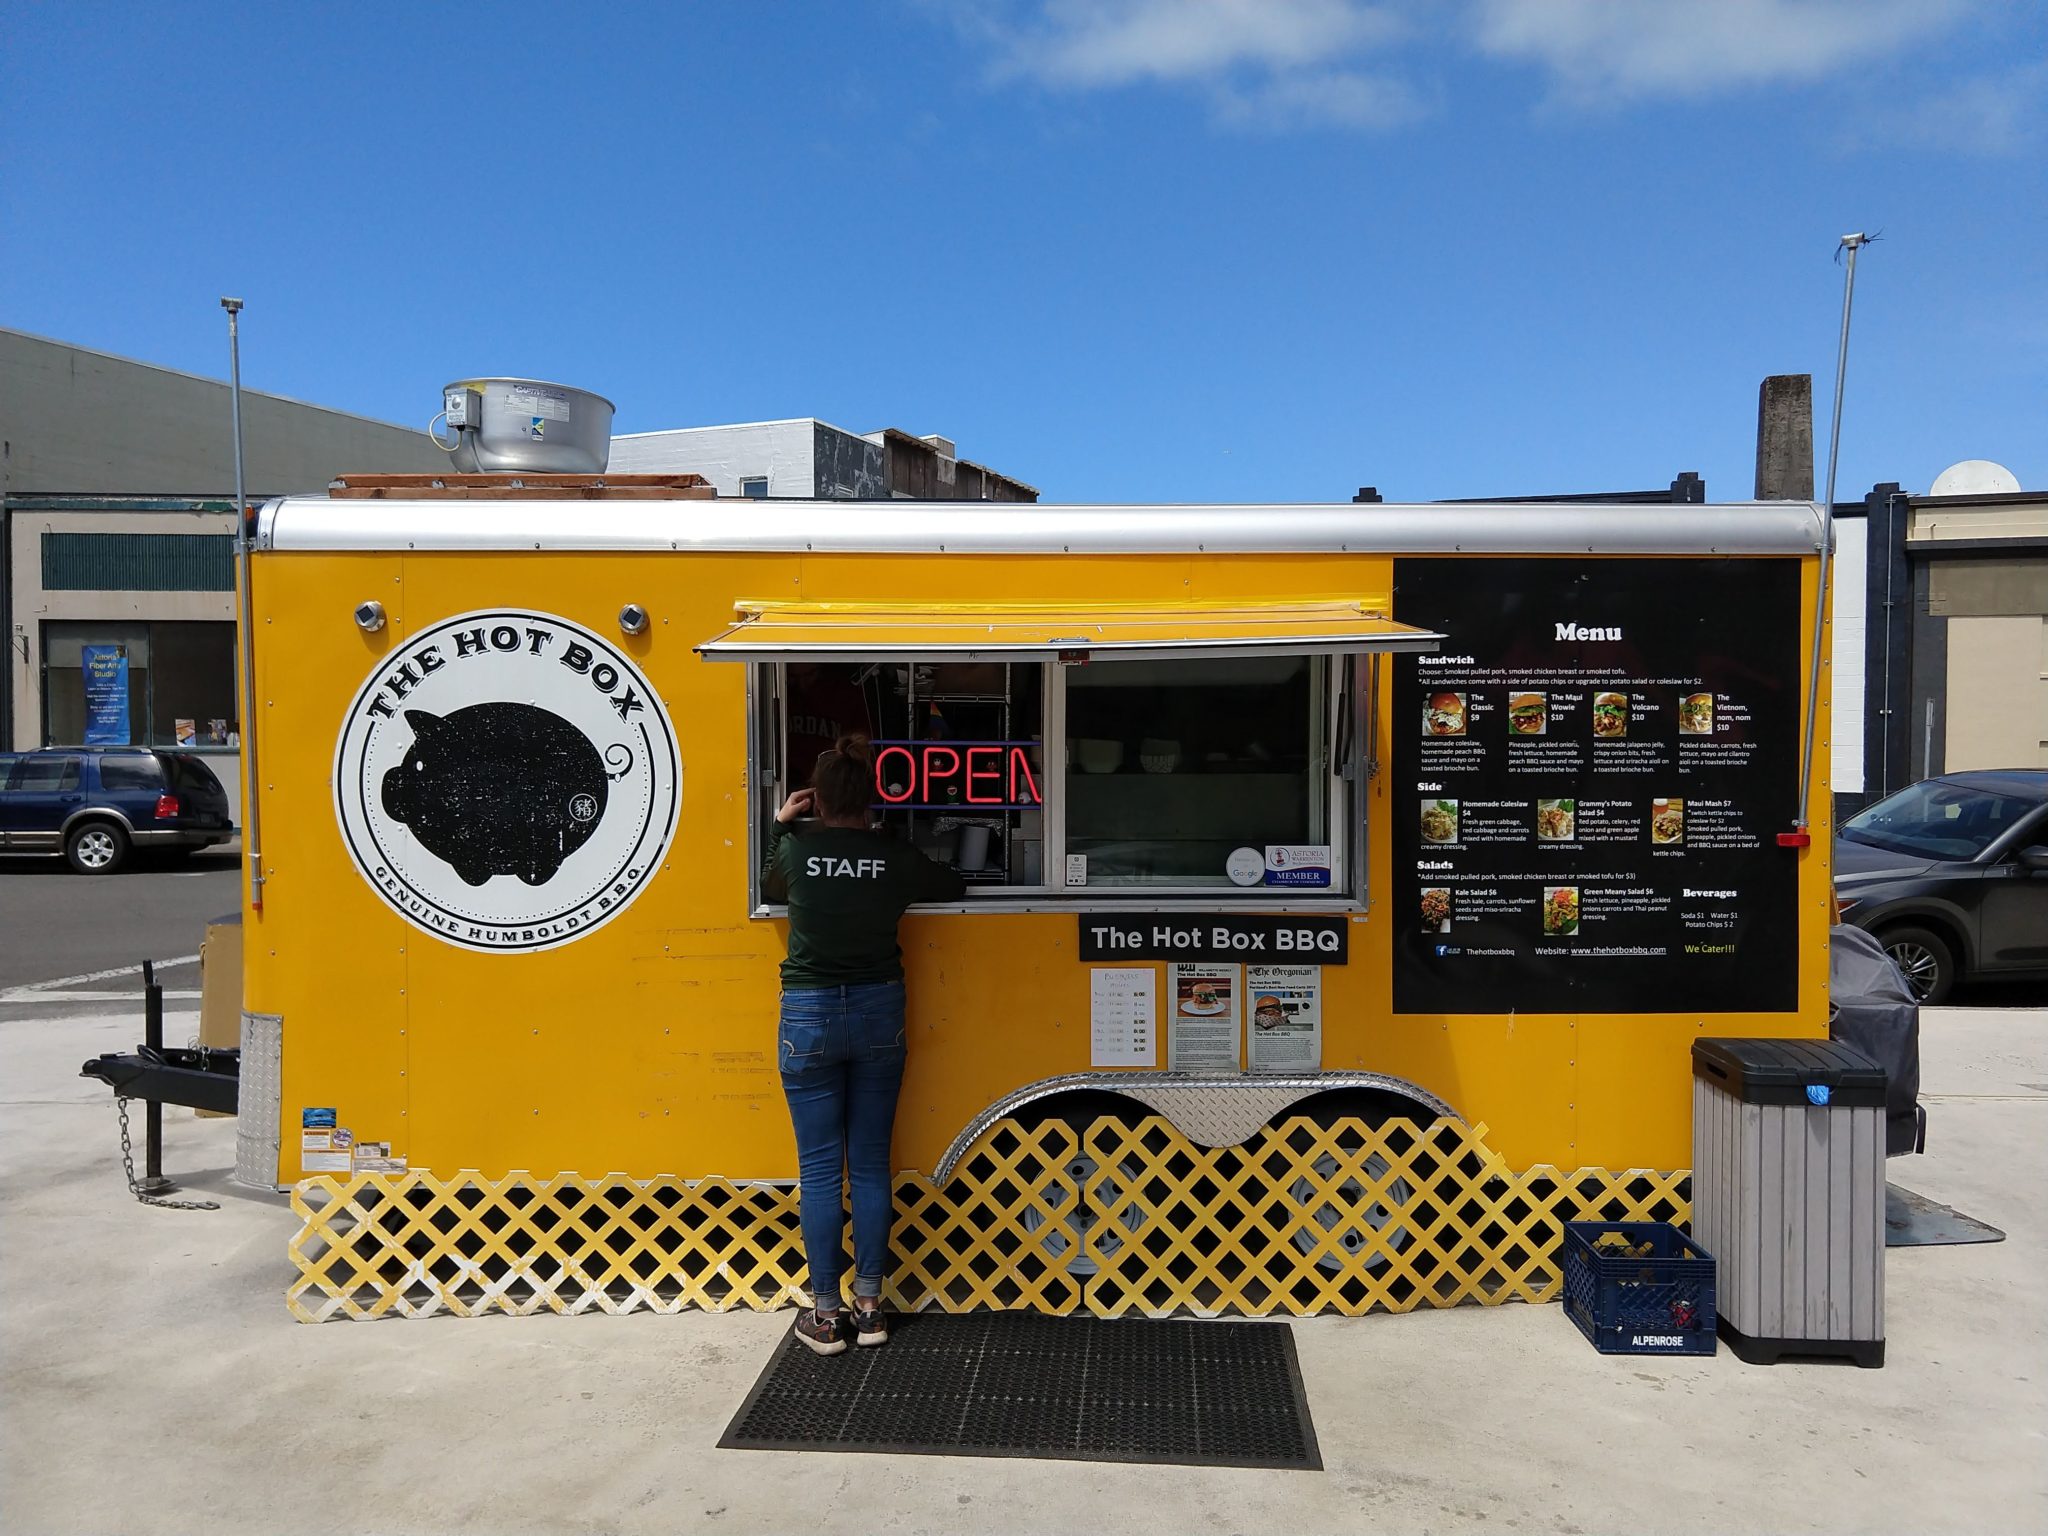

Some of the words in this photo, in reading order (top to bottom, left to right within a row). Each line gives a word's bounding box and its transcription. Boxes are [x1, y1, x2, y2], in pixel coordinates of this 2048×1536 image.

[1554, 622, 1623, 641] Menu
[1418, 656, 1475, 665] Sandwich
[367, 645, 446, 721] THE
[452, 625, 552, 658] HOT
[559, 640, 644, 722] BOX
[1470, 714, 1480, 722] $9
[1550, 713, 1564, 721] $10
[1631, 713, 1645, 721] $10
[1716, 723, 1730, 732] $10
[1417, 782, 1443, 791] Side
[806, 856, 886, 878] STAFF
[1417, 861, 1454, 870] Salads
[1233, 870, 1258, 878] Google
[1682, 888, 1738, 899] Beverages
[376, 866, 459, 932] GENUINE
[468, 910, 592, 942] HUMBOLDT
[598, 864, 646, 908] B.B.Q.
[1091, 927, 1142, 949] The
[1153, 927, 1202, 949] Hot
[1212, 928, 1266, 950] Box
[1277, 930, 1339, 952] BBQ
[1570, 946, 1667, 956] www.thehotboxbbq.com
[1684, 945, 1700, 953] We
[1701, 945, 1735, 953] Cater!!!
[1253, 967, 1270, 977] The
[1272, 967, 1312, 977] Oregonian
[1632, 1336, 1683, 1346] ALPENROSE
